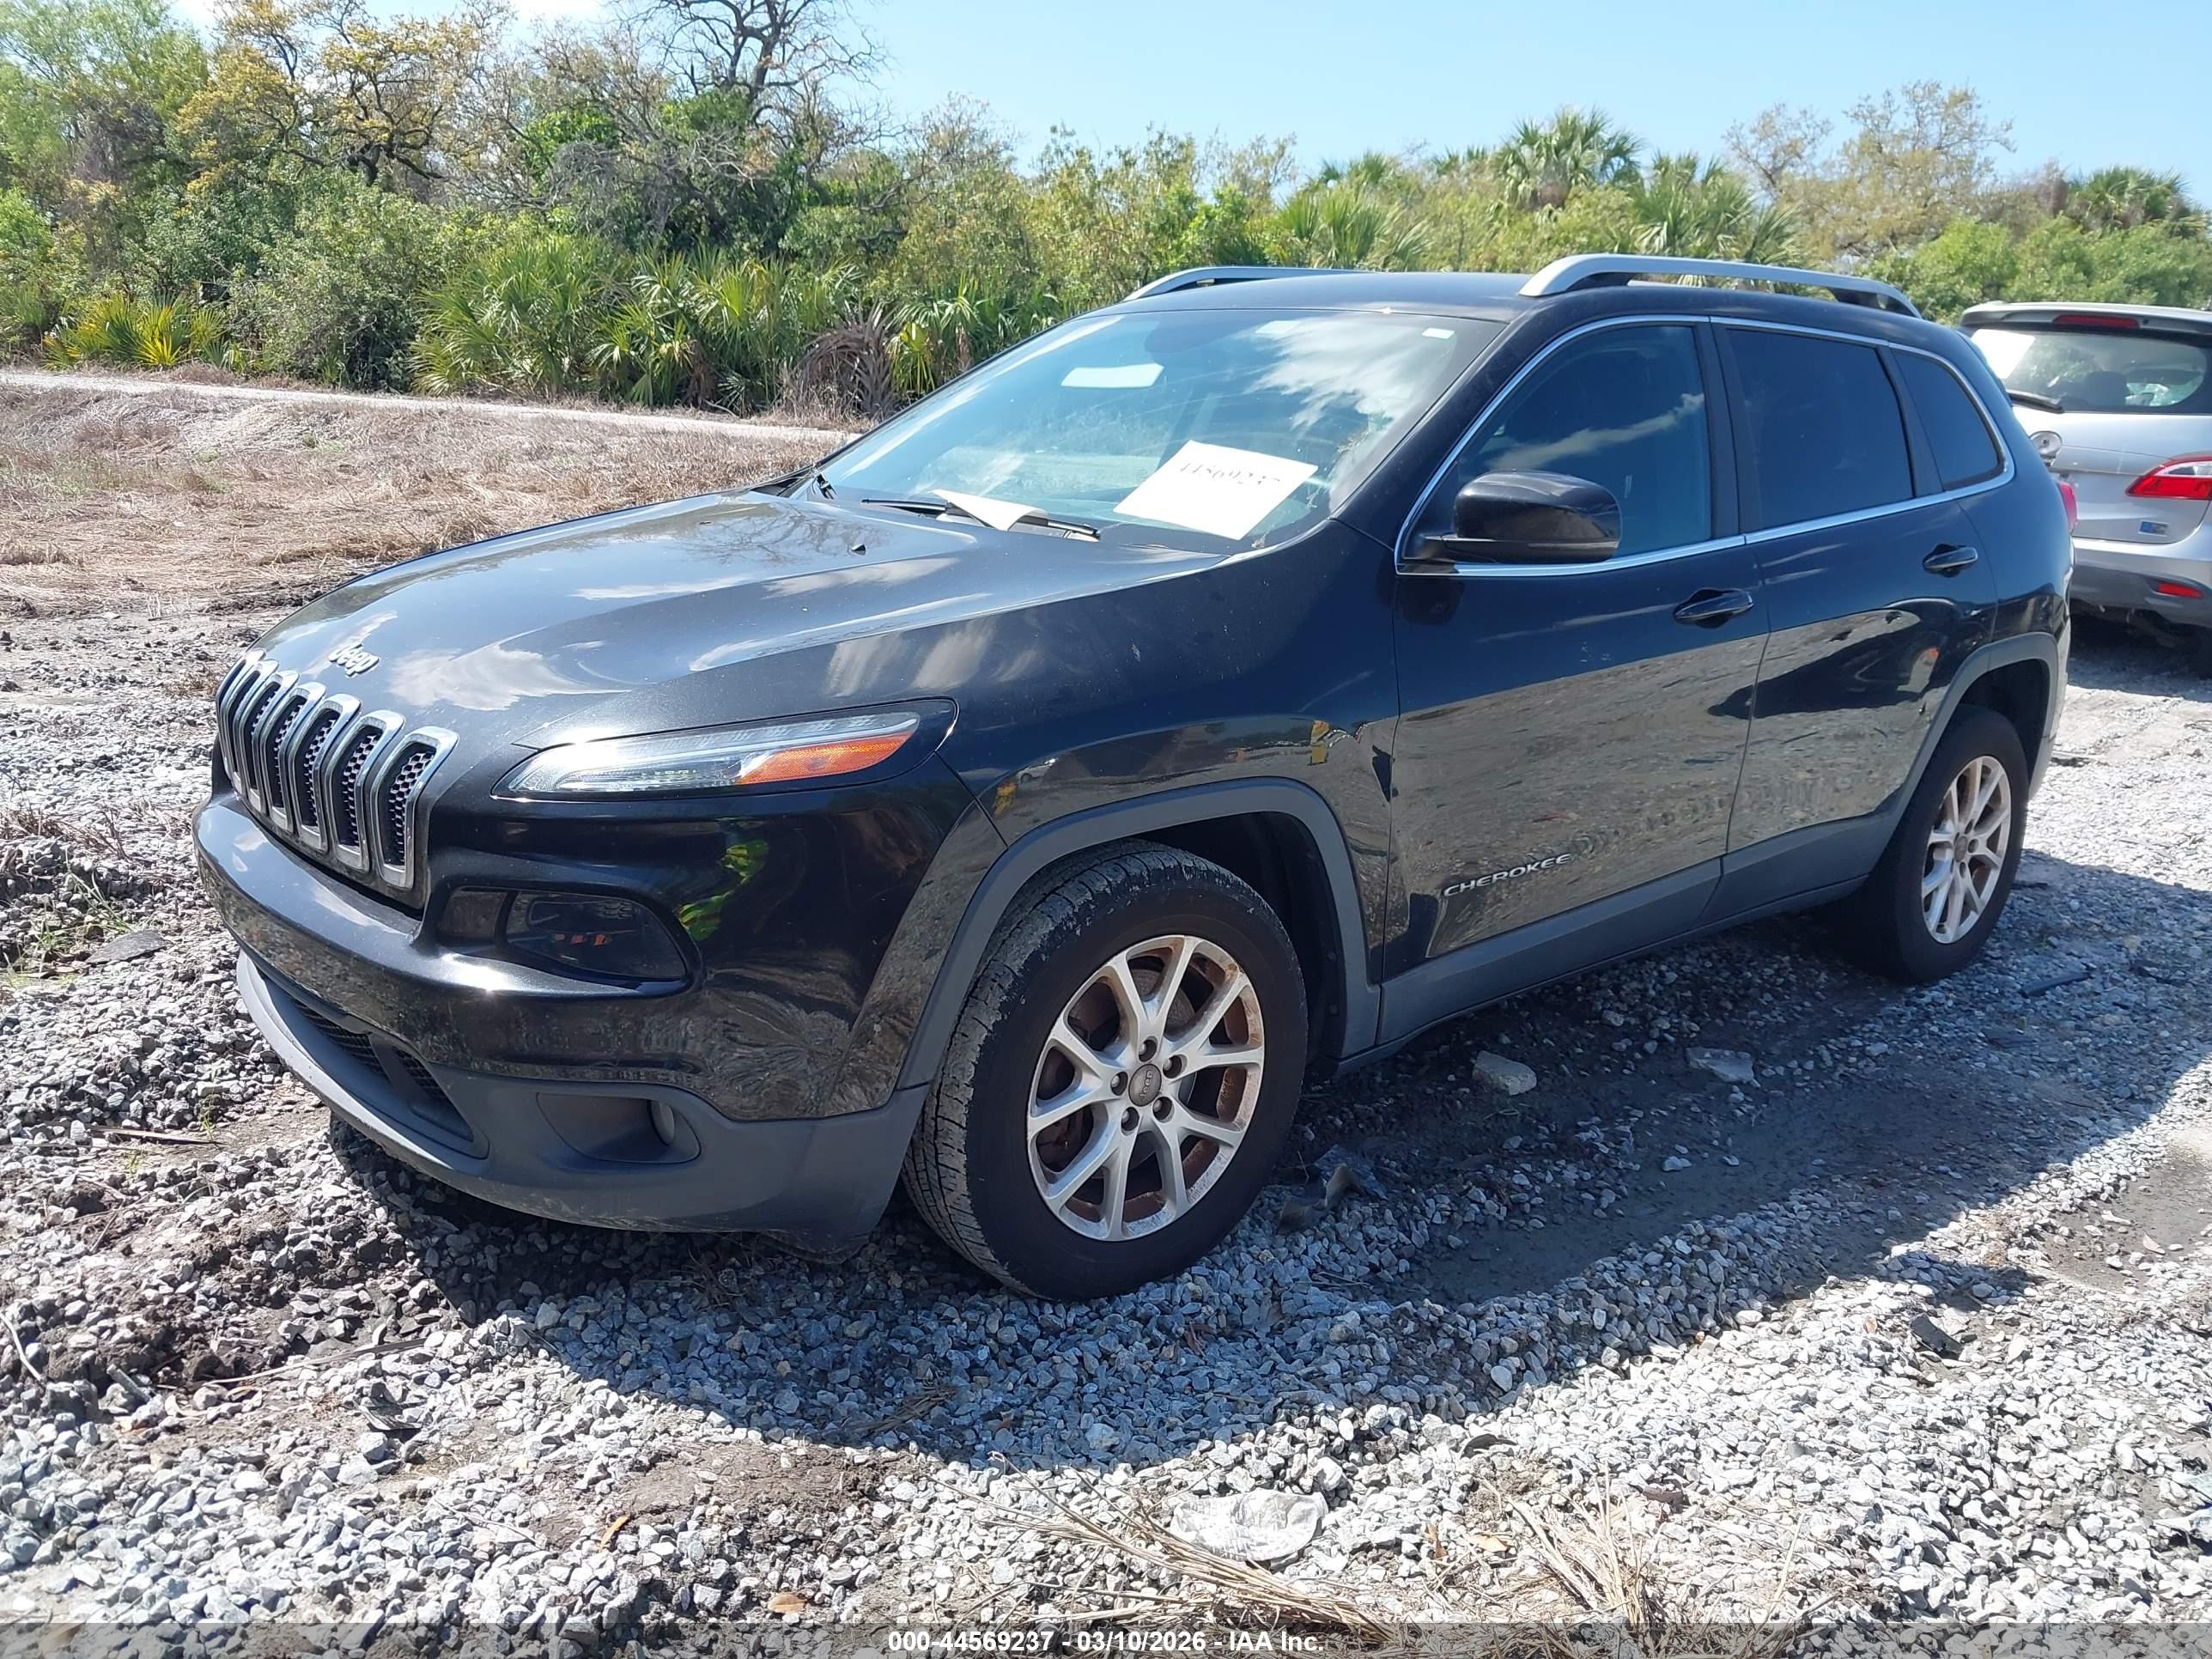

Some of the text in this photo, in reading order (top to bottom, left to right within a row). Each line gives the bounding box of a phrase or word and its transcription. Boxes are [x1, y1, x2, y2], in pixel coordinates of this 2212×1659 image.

[329, 643, 380, 677] Jeep
[1443, 853, 1572, 897] CHEROKEE
[1139, 1069, 1154, 1101] Jeep
